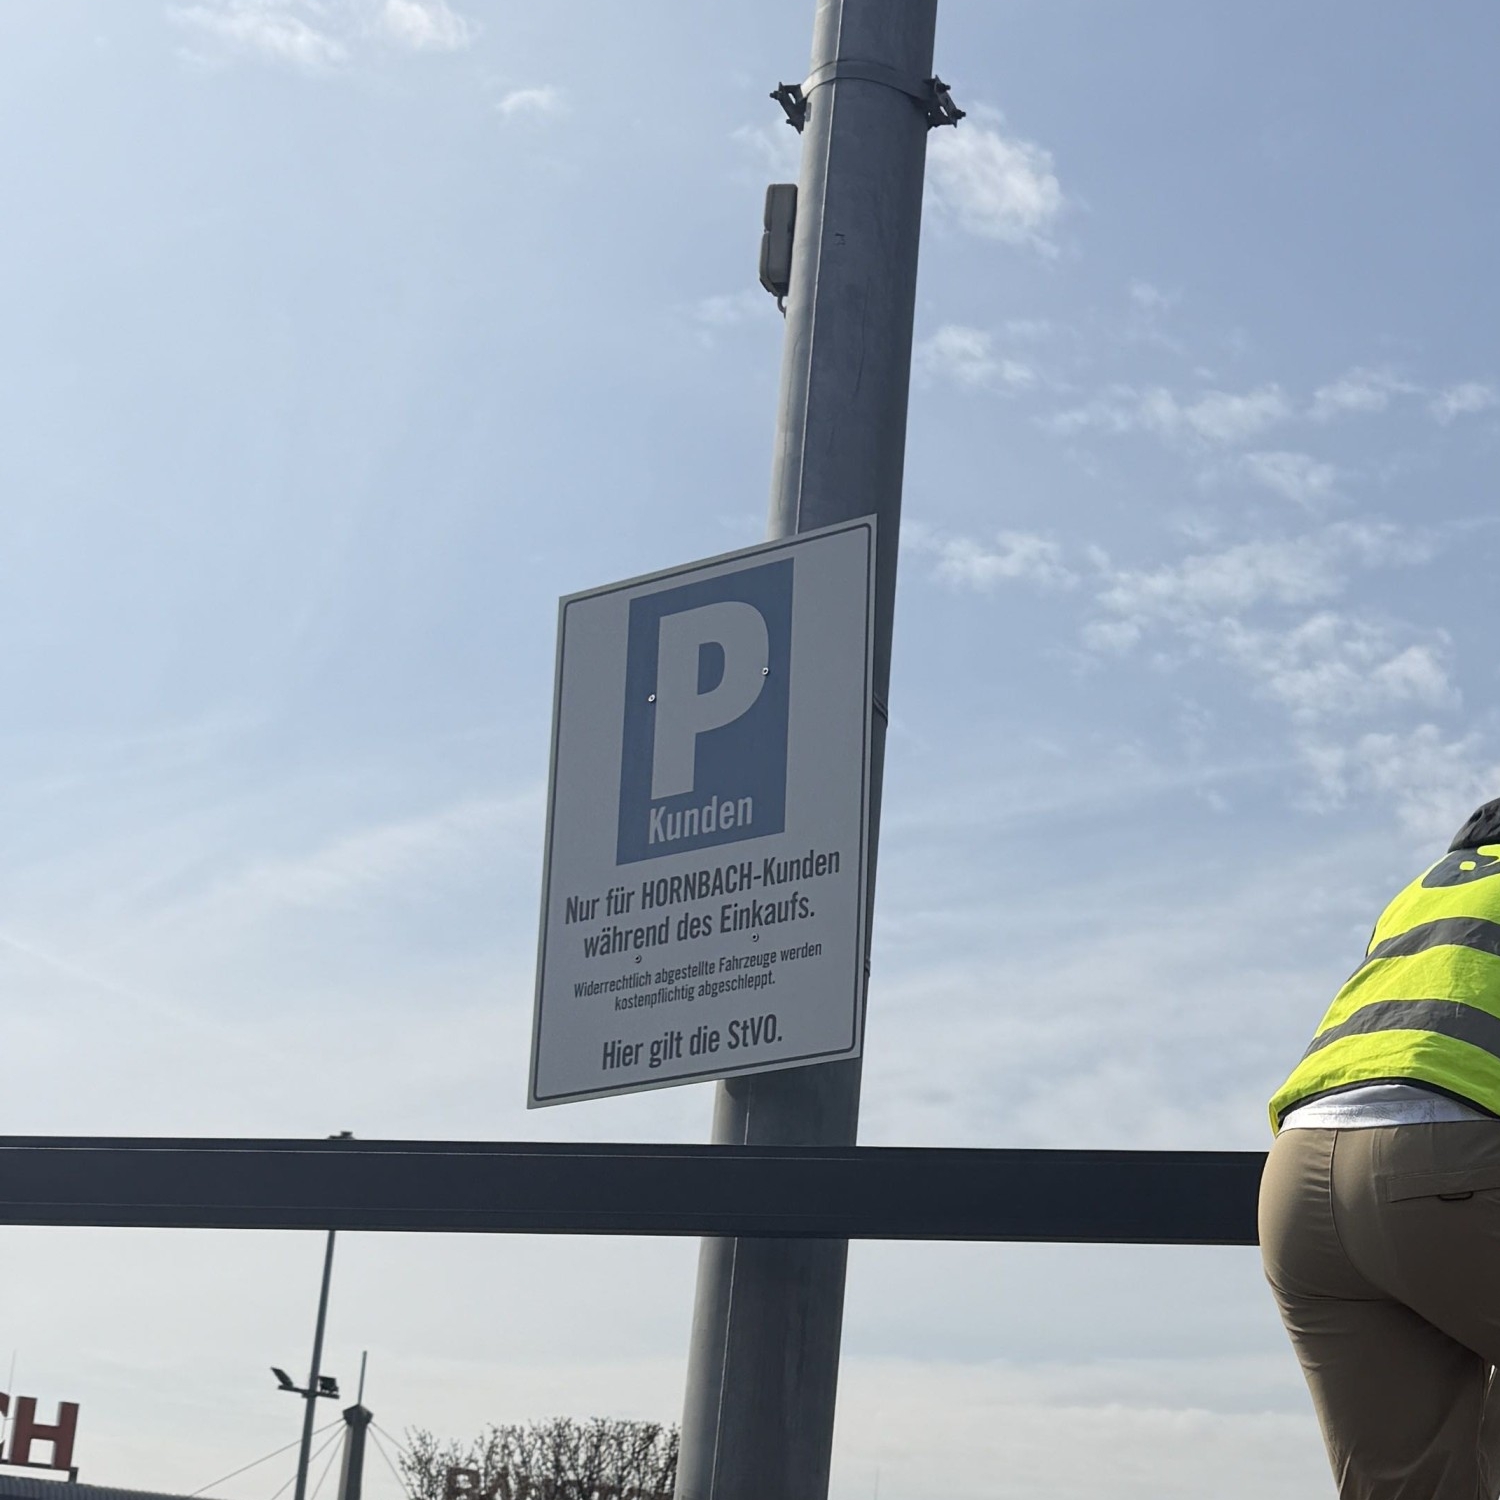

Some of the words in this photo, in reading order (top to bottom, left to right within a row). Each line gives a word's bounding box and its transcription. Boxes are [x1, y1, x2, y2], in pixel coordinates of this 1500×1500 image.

[651, 601, 769, 800] P
[649, 795, 753, 845] Kunden
[565, 896, 599, 925] Nur
[606, 887, 635, 917] für
[641, 850, 840, 910] HORNBACH-Kunden
[584, 916, 669, 958] während
[677, 912, 713, 941] des
[720, 891, 815, 933] Einkaufs.
[574, 971, 652, 998] Widerrechtlich
[654, 961, 715, 987] abgestellte
[719, 951, 777, 974] Fahrzeuge
[780, 942, 822, 963] werden
[614, 985, 695, 1011] kostenpflichtig
[698, 971, 776, 998] abgeschleppt.
[602, 1040, 643, 1070] Hier
[649, 1030, 682, 1068] gilt
[690, 1025, 720, 1055] die
[727, 1013, 783, 1049] StVO.
